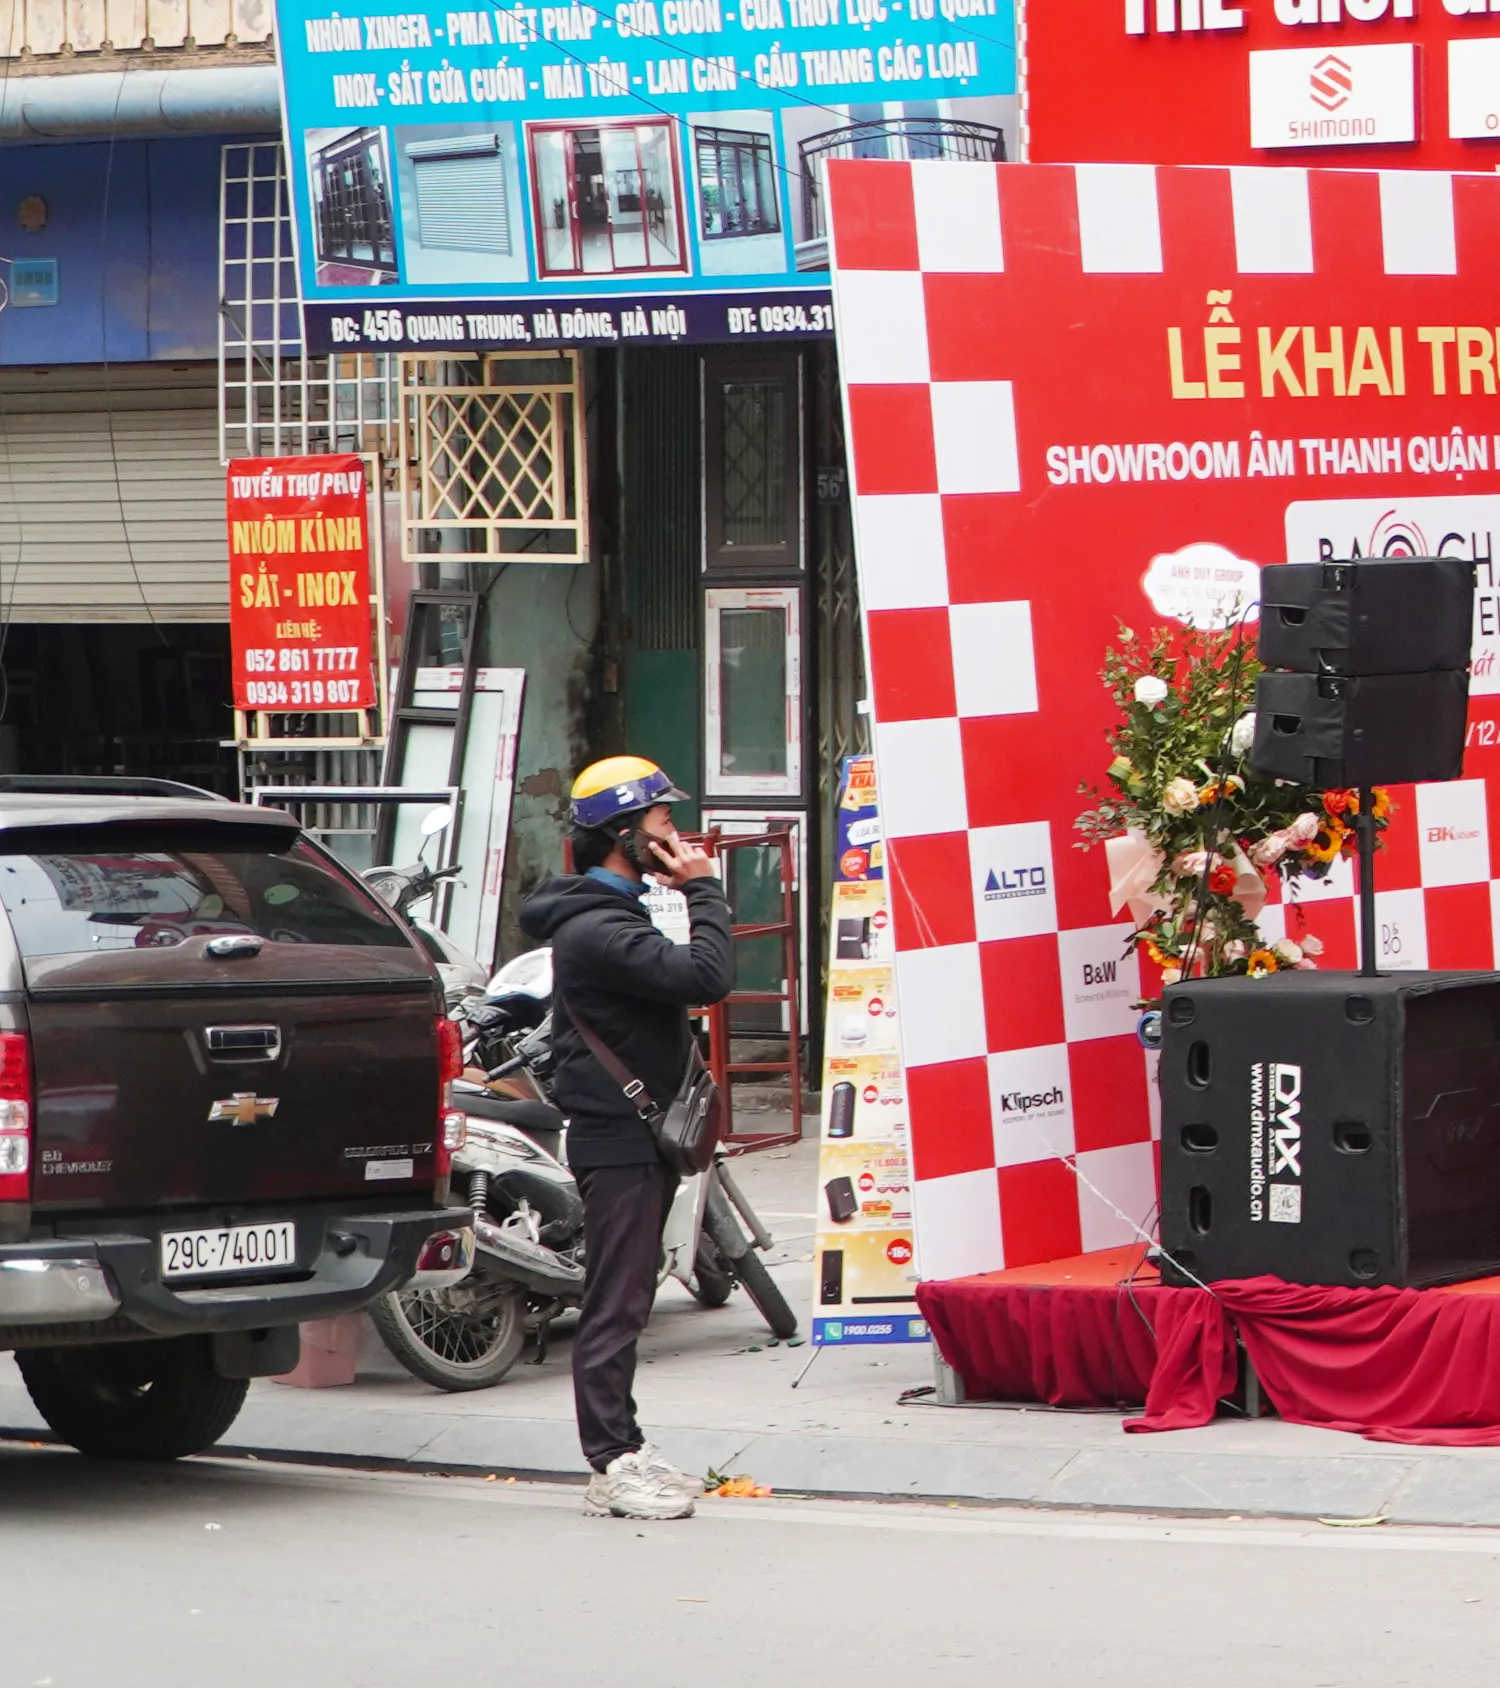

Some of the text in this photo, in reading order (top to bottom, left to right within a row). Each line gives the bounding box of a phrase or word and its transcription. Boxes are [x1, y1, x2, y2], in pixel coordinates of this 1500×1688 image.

[1166, 289, 1243, 401] LỄ
[1257, 322, 1405, 400] KHAI
[1045, 437, 1239, 488] SHOWROOM
[1247, 430, 1293, 481] ÂM
[1298, 434, 1402, 477] THANH
[1407, 430, 1487, 485] QUẬN
[231, 466, 363, 501] TUYỂN THỢ PHỤ
[232, 512, 363, 555] NHÔM KÍNH
[240, 561, 359, 609] SẮT INOX
[246, 680, 360, 705] 0934 319 807
[1274, 1062, 1302, 1176] DMX
